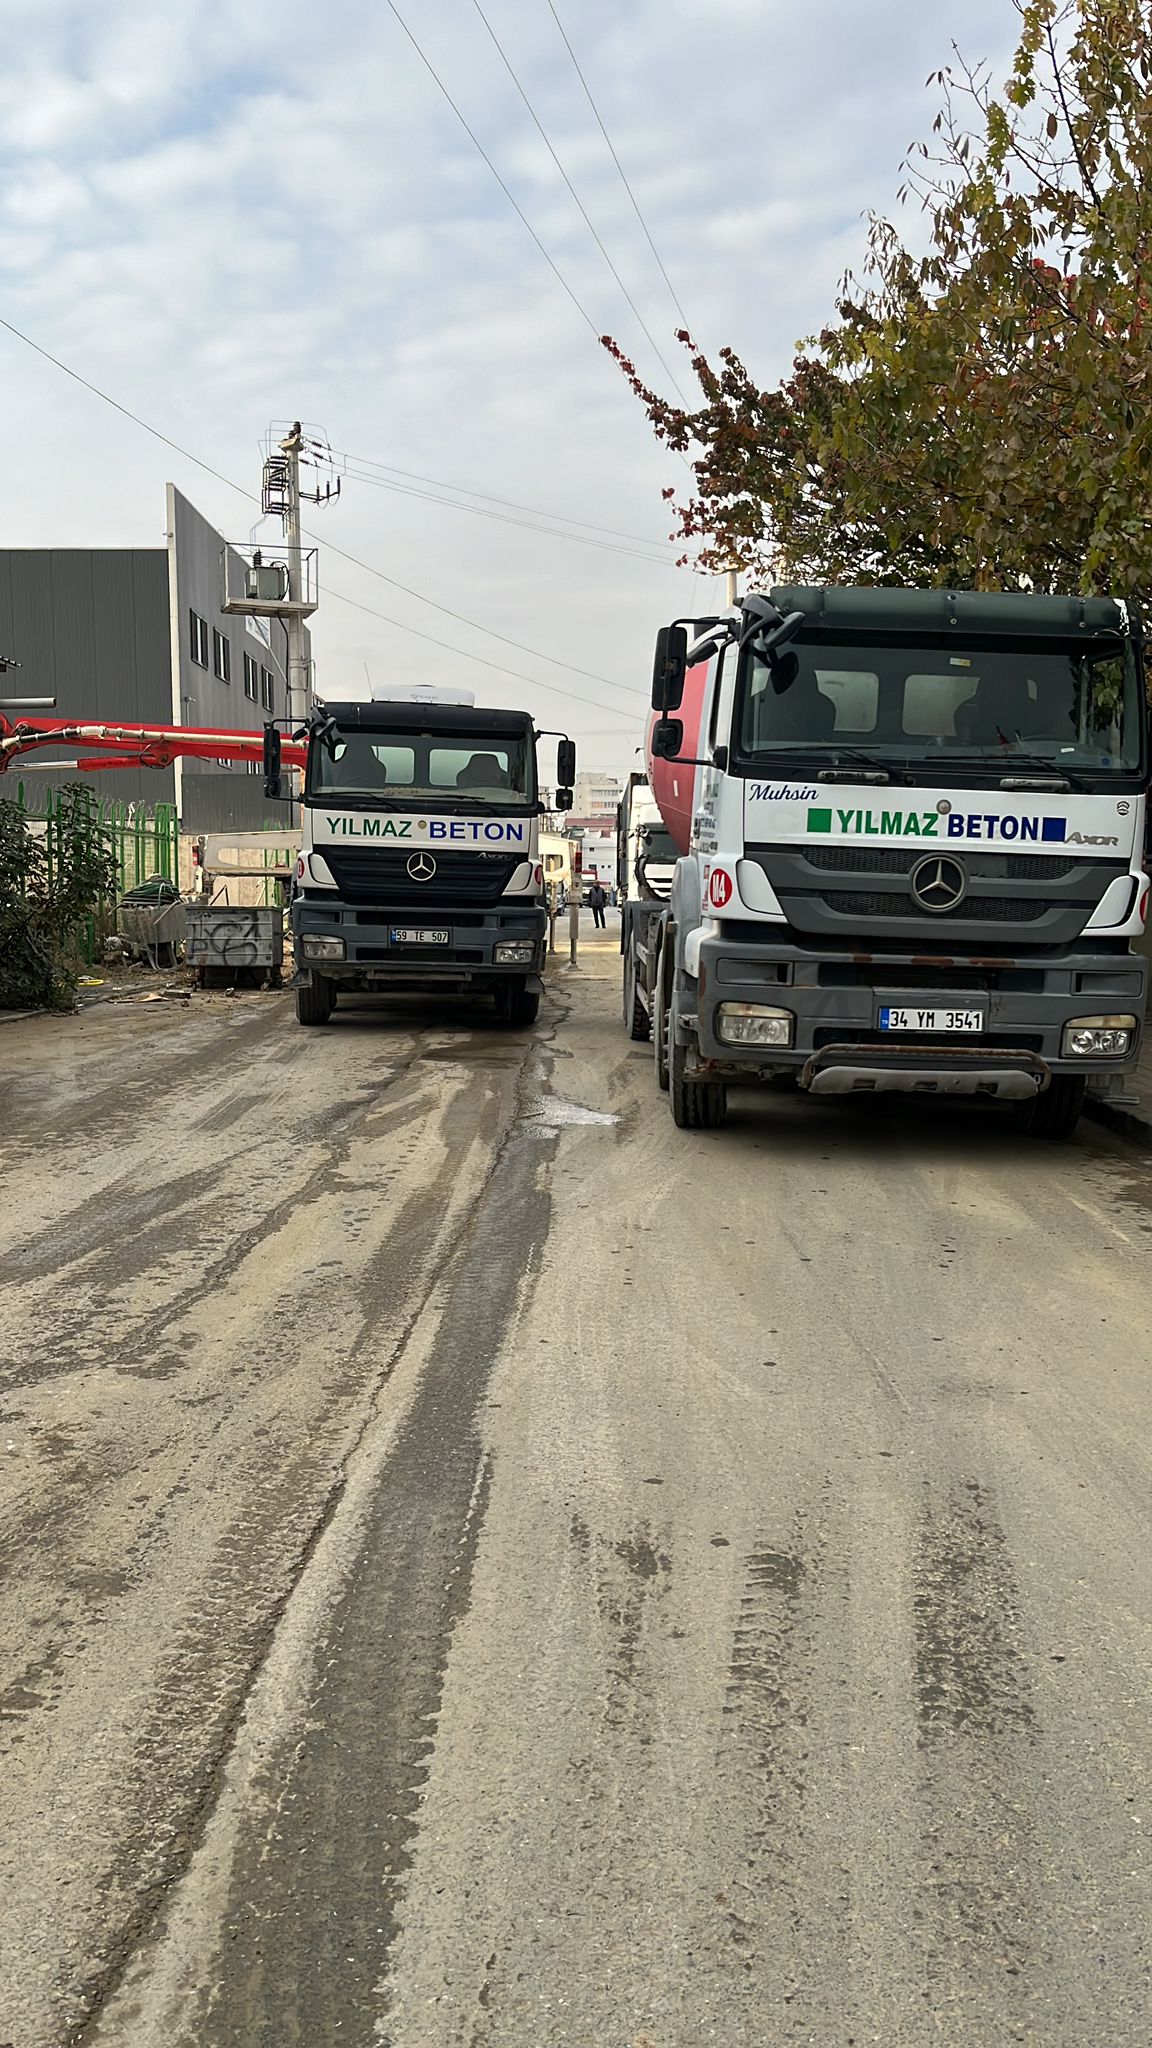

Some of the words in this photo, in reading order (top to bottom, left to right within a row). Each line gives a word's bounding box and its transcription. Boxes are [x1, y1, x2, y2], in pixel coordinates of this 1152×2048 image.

[748, 783, 819, 801] Muhsin
[326, 817, 412, 838] YILMAZ
[429, 821, 523, 841] BETON
[837, 810, 939, 836] YILMAZ
[948, 814, 1039, 841] BETON
[396, 931, 407, 940] 59
[414, 932, 425, 941] TE
[432, 933, 448, 942] 507
[890, 1011, 908, 1027] 34
[917, 1012, 935, 1028] YM
[945, 1013, 980, 1029] 3541
